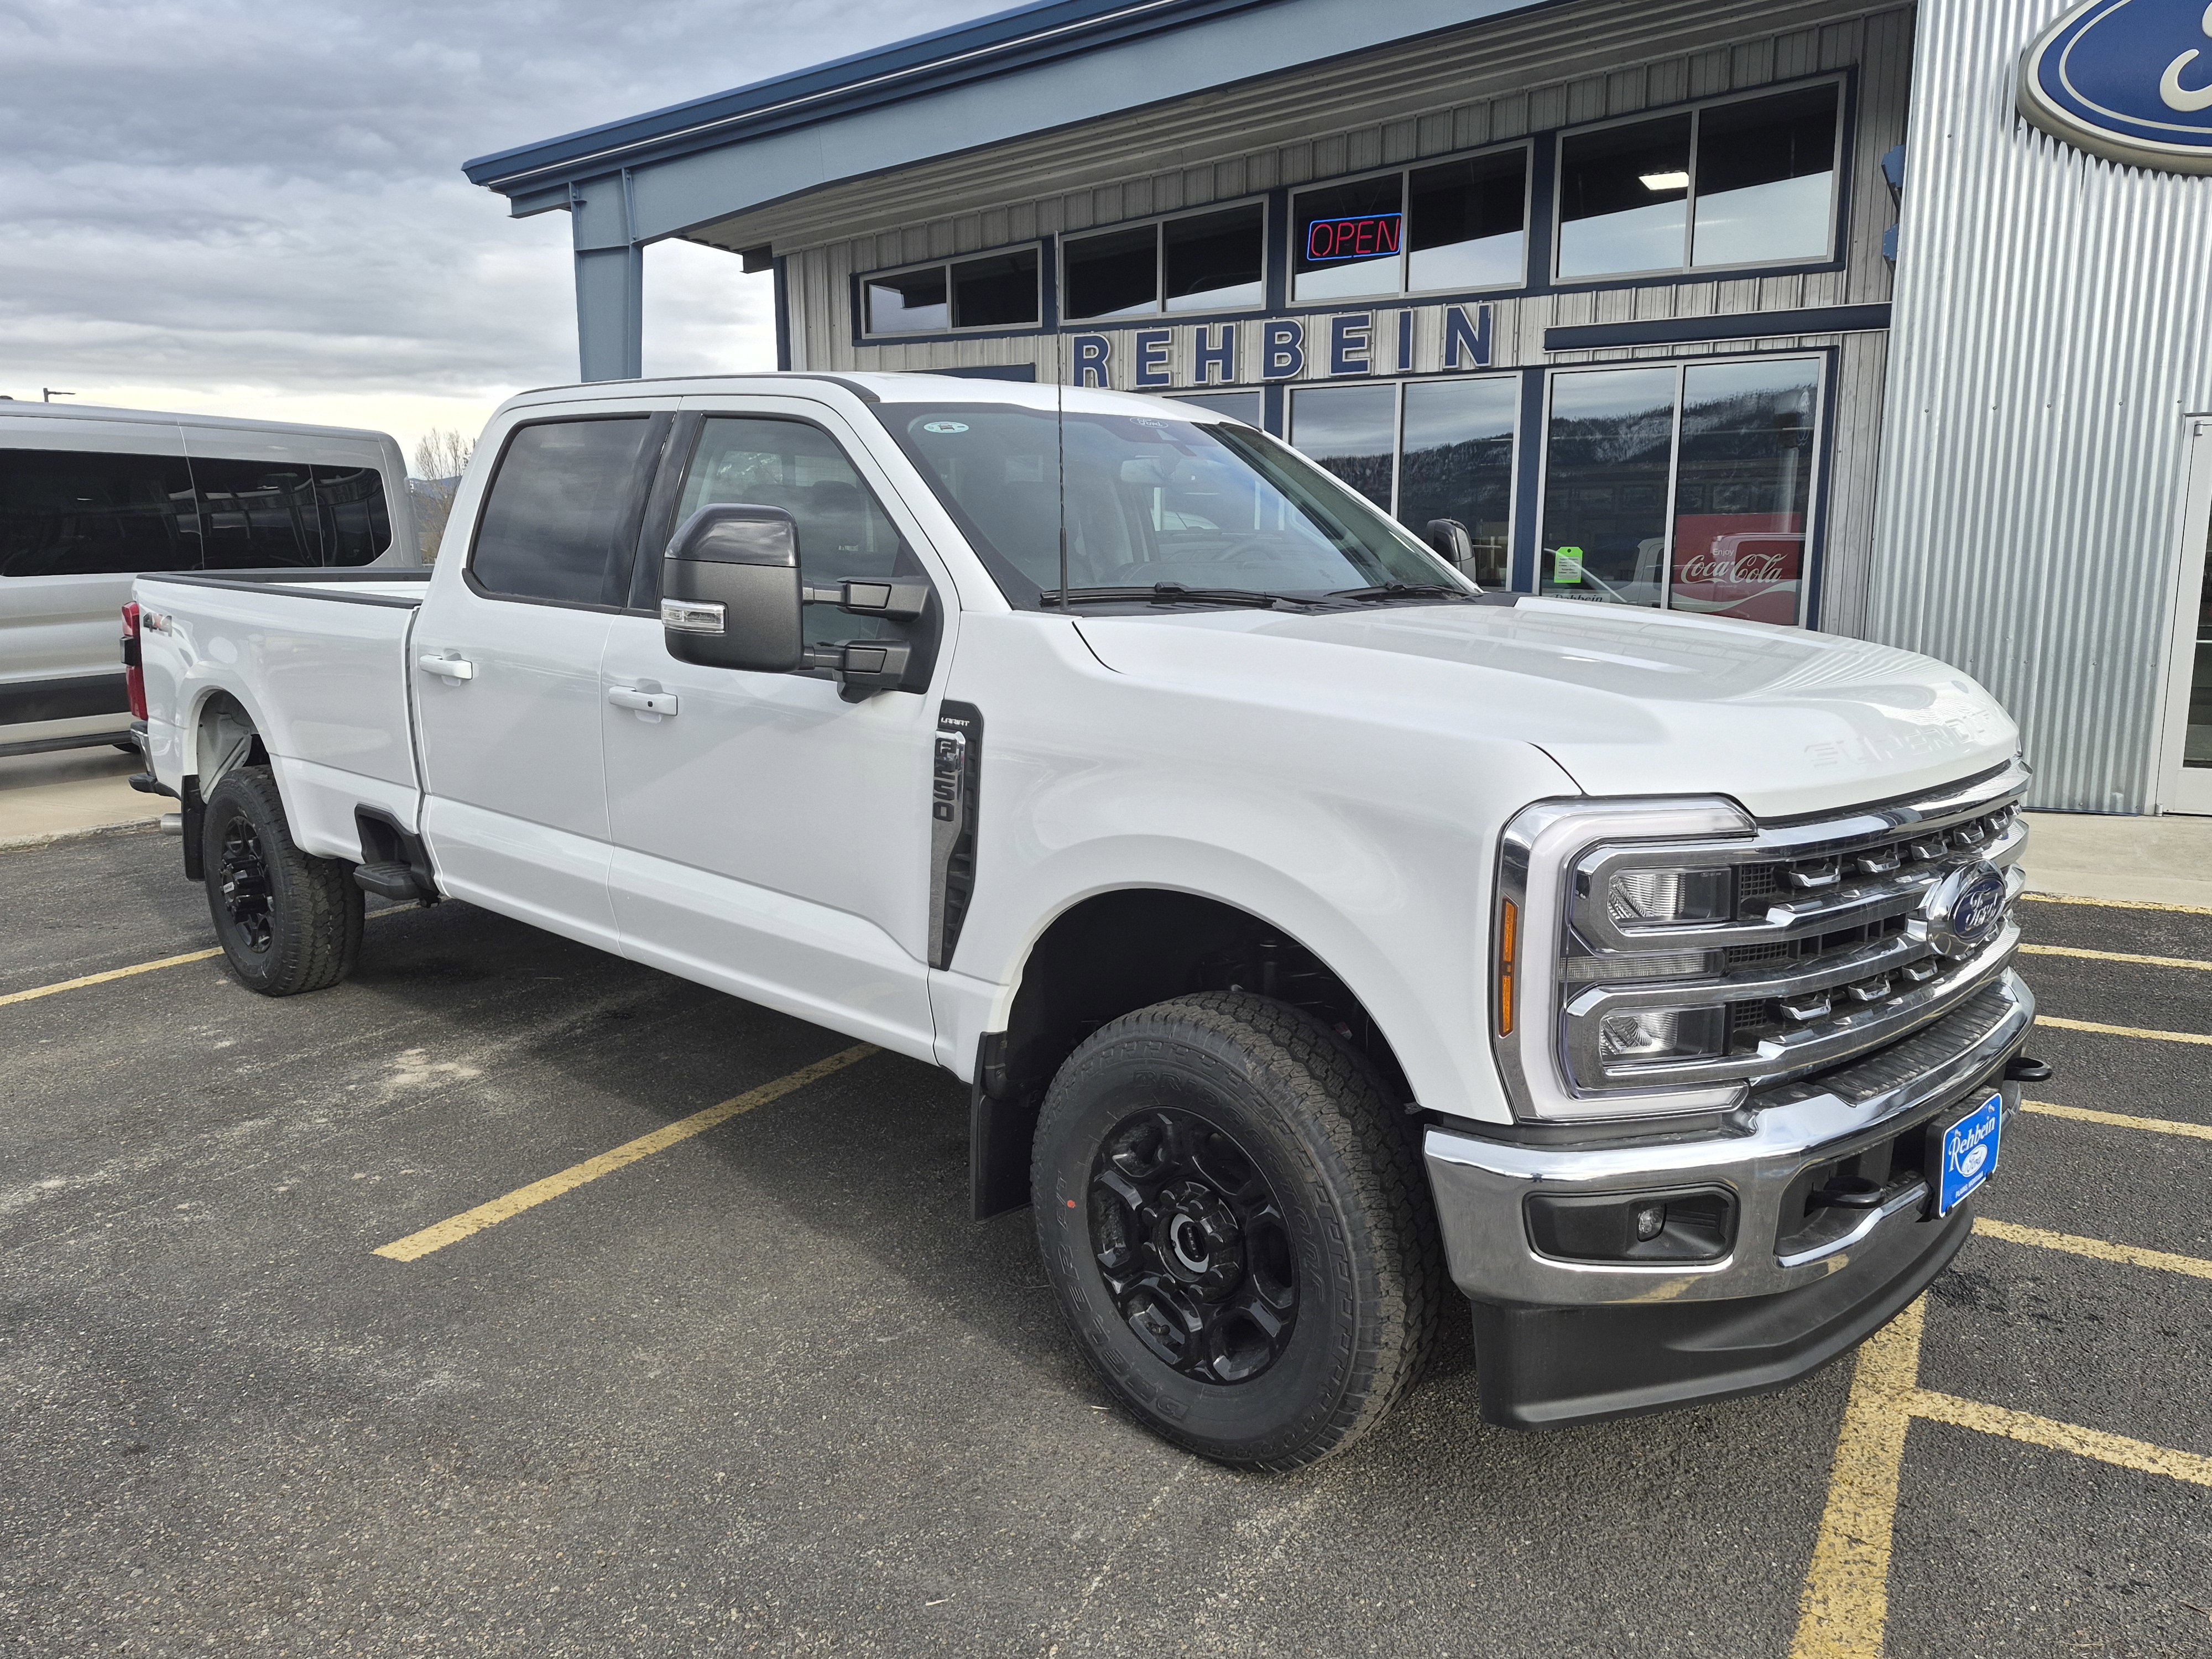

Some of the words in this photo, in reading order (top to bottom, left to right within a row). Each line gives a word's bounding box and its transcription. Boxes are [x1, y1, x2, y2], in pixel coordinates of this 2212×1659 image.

[1311, 218, 1400, 256] OPEN
[1073, 302, 1494, 388] REHBEIN
[1681, 554, 1788, 584] Coca-Cola
[941, 717, 970, 727] LARIAT
[1965, 887, 1999, 932] Ford
[1948, 1116, 1995, 1175] Rehbein
